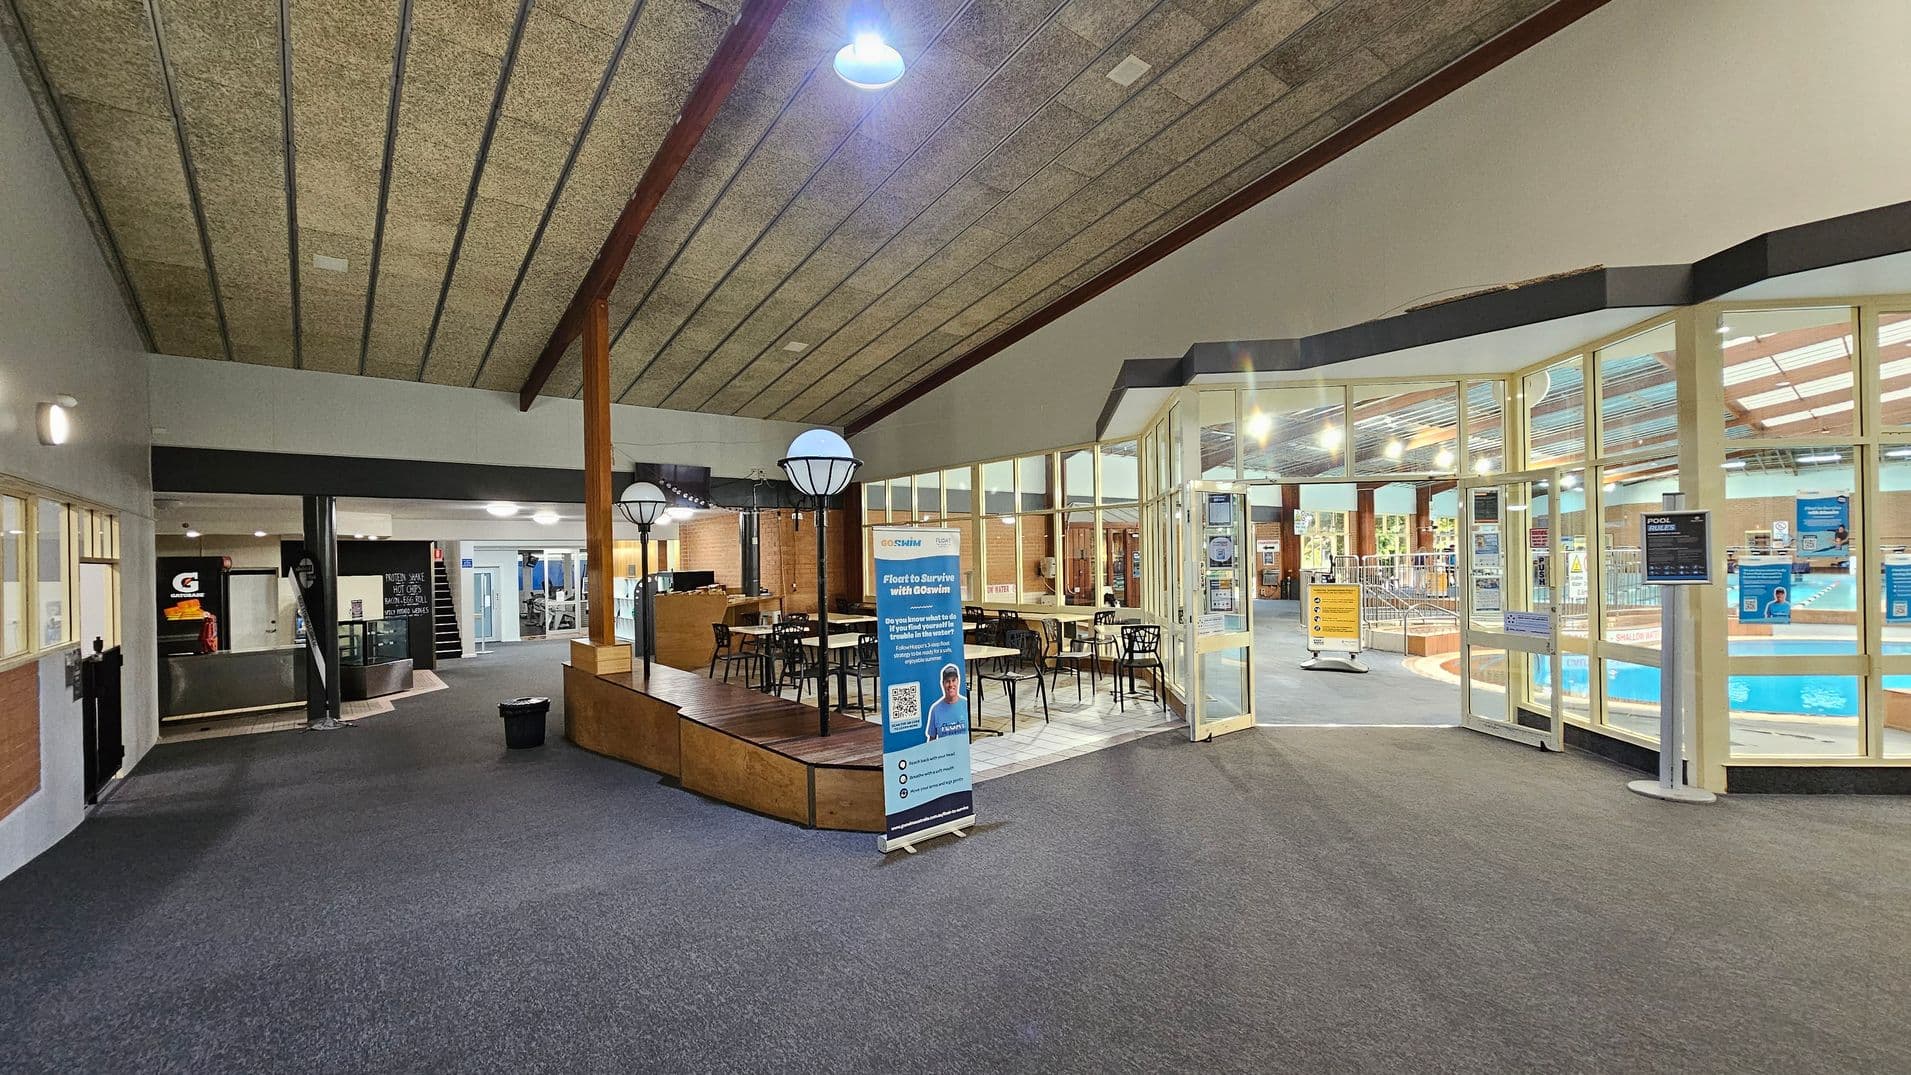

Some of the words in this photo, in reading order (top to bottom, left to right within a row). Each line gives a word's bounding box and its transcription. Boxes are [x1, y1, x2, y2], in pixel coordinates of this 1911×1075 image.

[1538, 556, 1546, 586] PUSH
[883, 574, 909, 583] Float
[920, 572, 955, 583] Survive
[392, 584, 404, 593] HOT
[890, 586, 912, 595] with
[913, 584, 951, 595] GOswim
[895, 625, 908, 633] you
[922, 622, 948, 630] yourself
